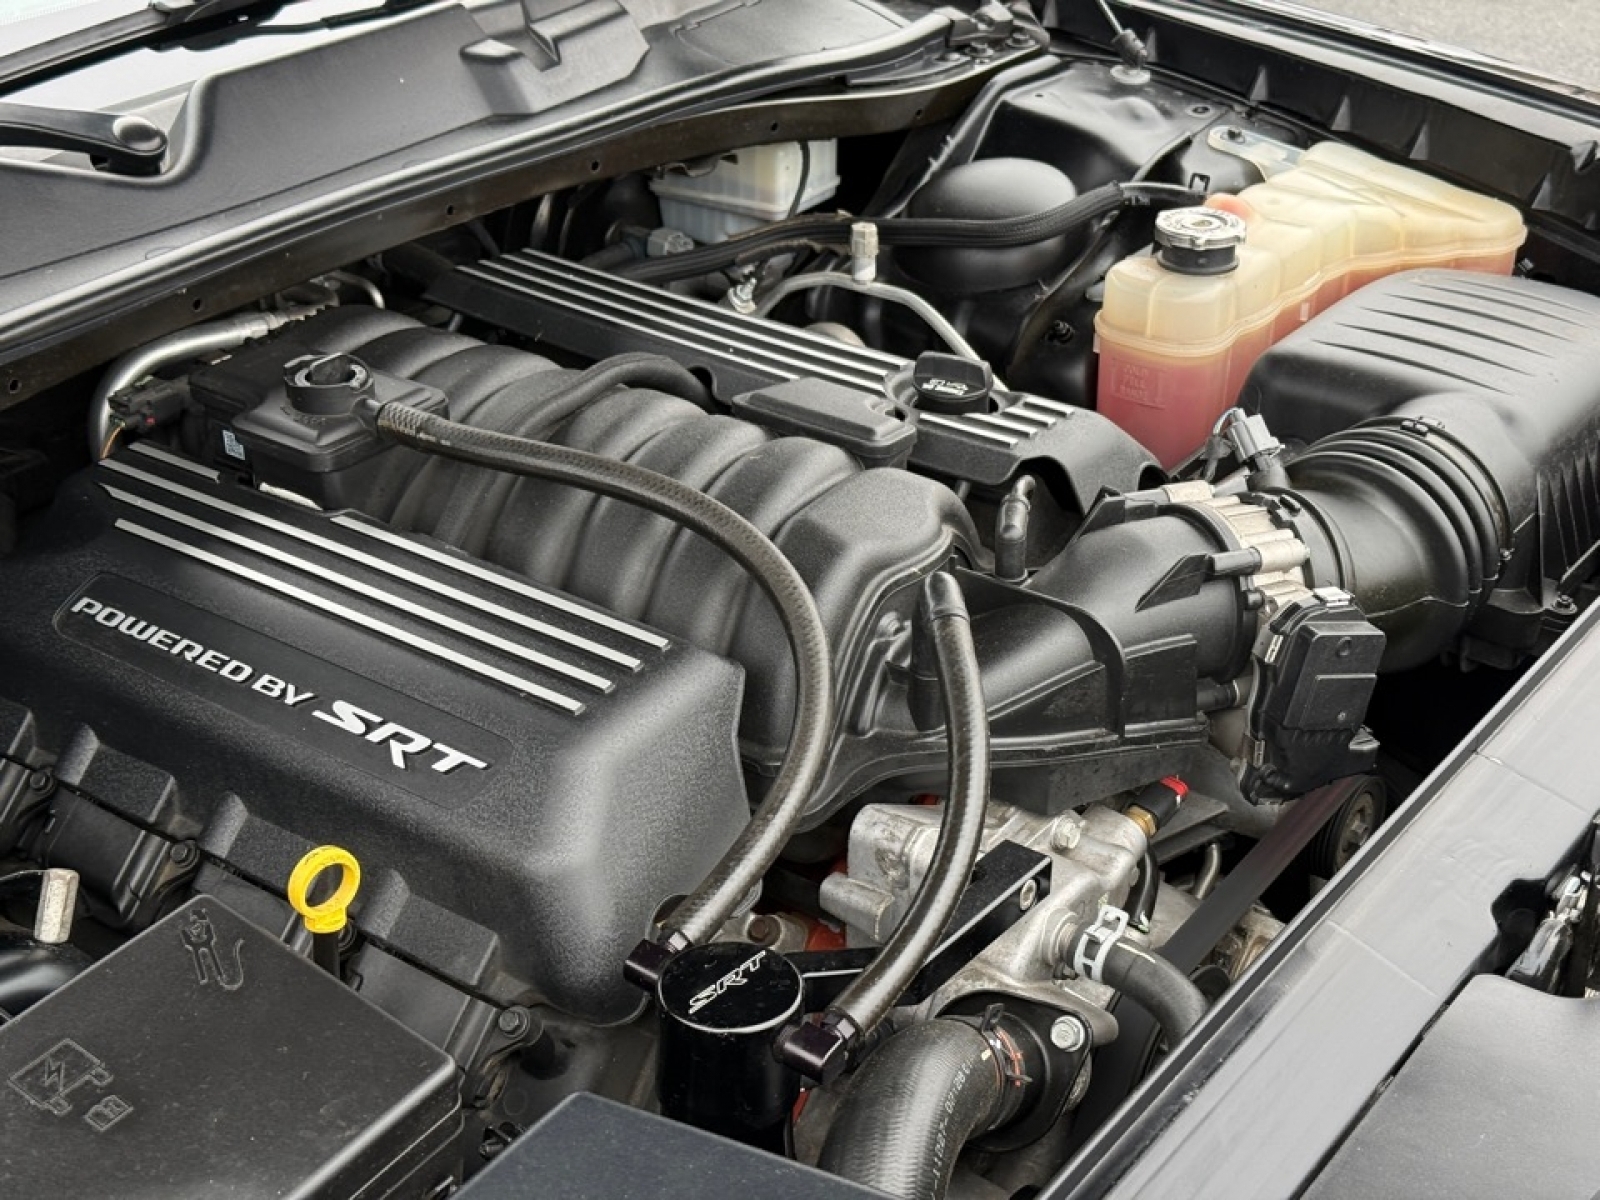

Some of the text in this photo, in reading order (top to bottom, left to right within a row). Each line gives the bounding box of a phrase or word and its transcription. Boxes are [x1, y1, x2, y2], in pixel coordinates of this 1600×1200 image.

[71, 596, 489, 774] POWERED BY SRT
[688, 949, 767, 1015] SRT
